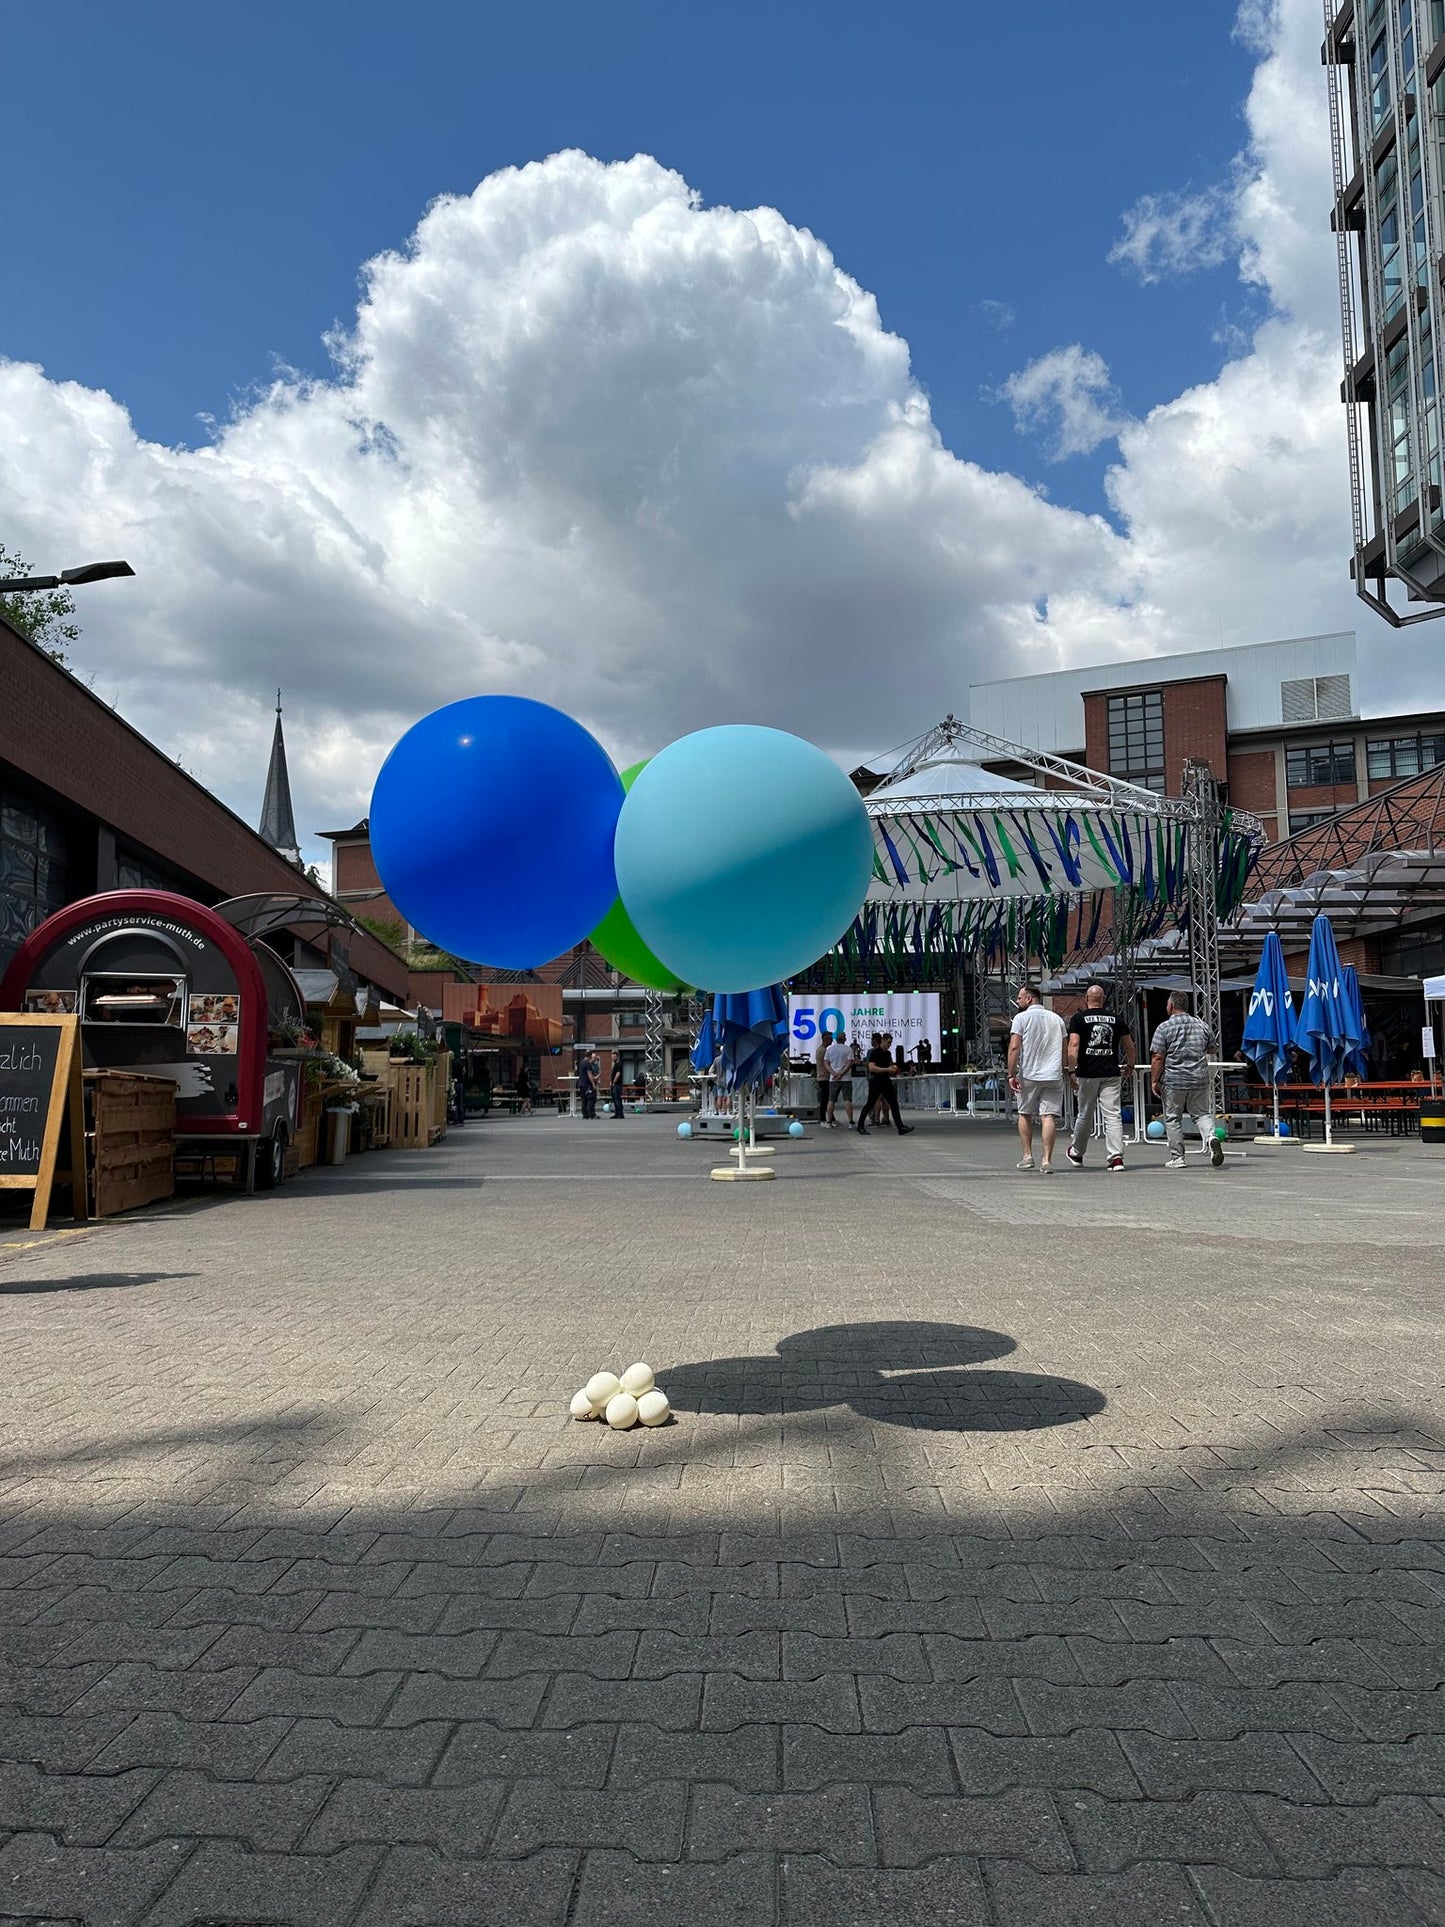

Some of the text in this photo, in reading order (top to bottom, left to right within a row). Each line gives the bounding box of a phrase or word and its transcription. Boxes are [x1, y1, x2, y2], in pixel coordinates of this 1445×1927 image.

[67, 916, 205, 950] www.partyservice-muth.de
[851, 1008, 884, 1016] JAHRE
[793, 1007, 845, 1041] 50
[851, 1019, 923, 1028] MANNHEIMER
[0, 1116, 17, 1133] cht
[10, 1138, 39, 1161] Muth
